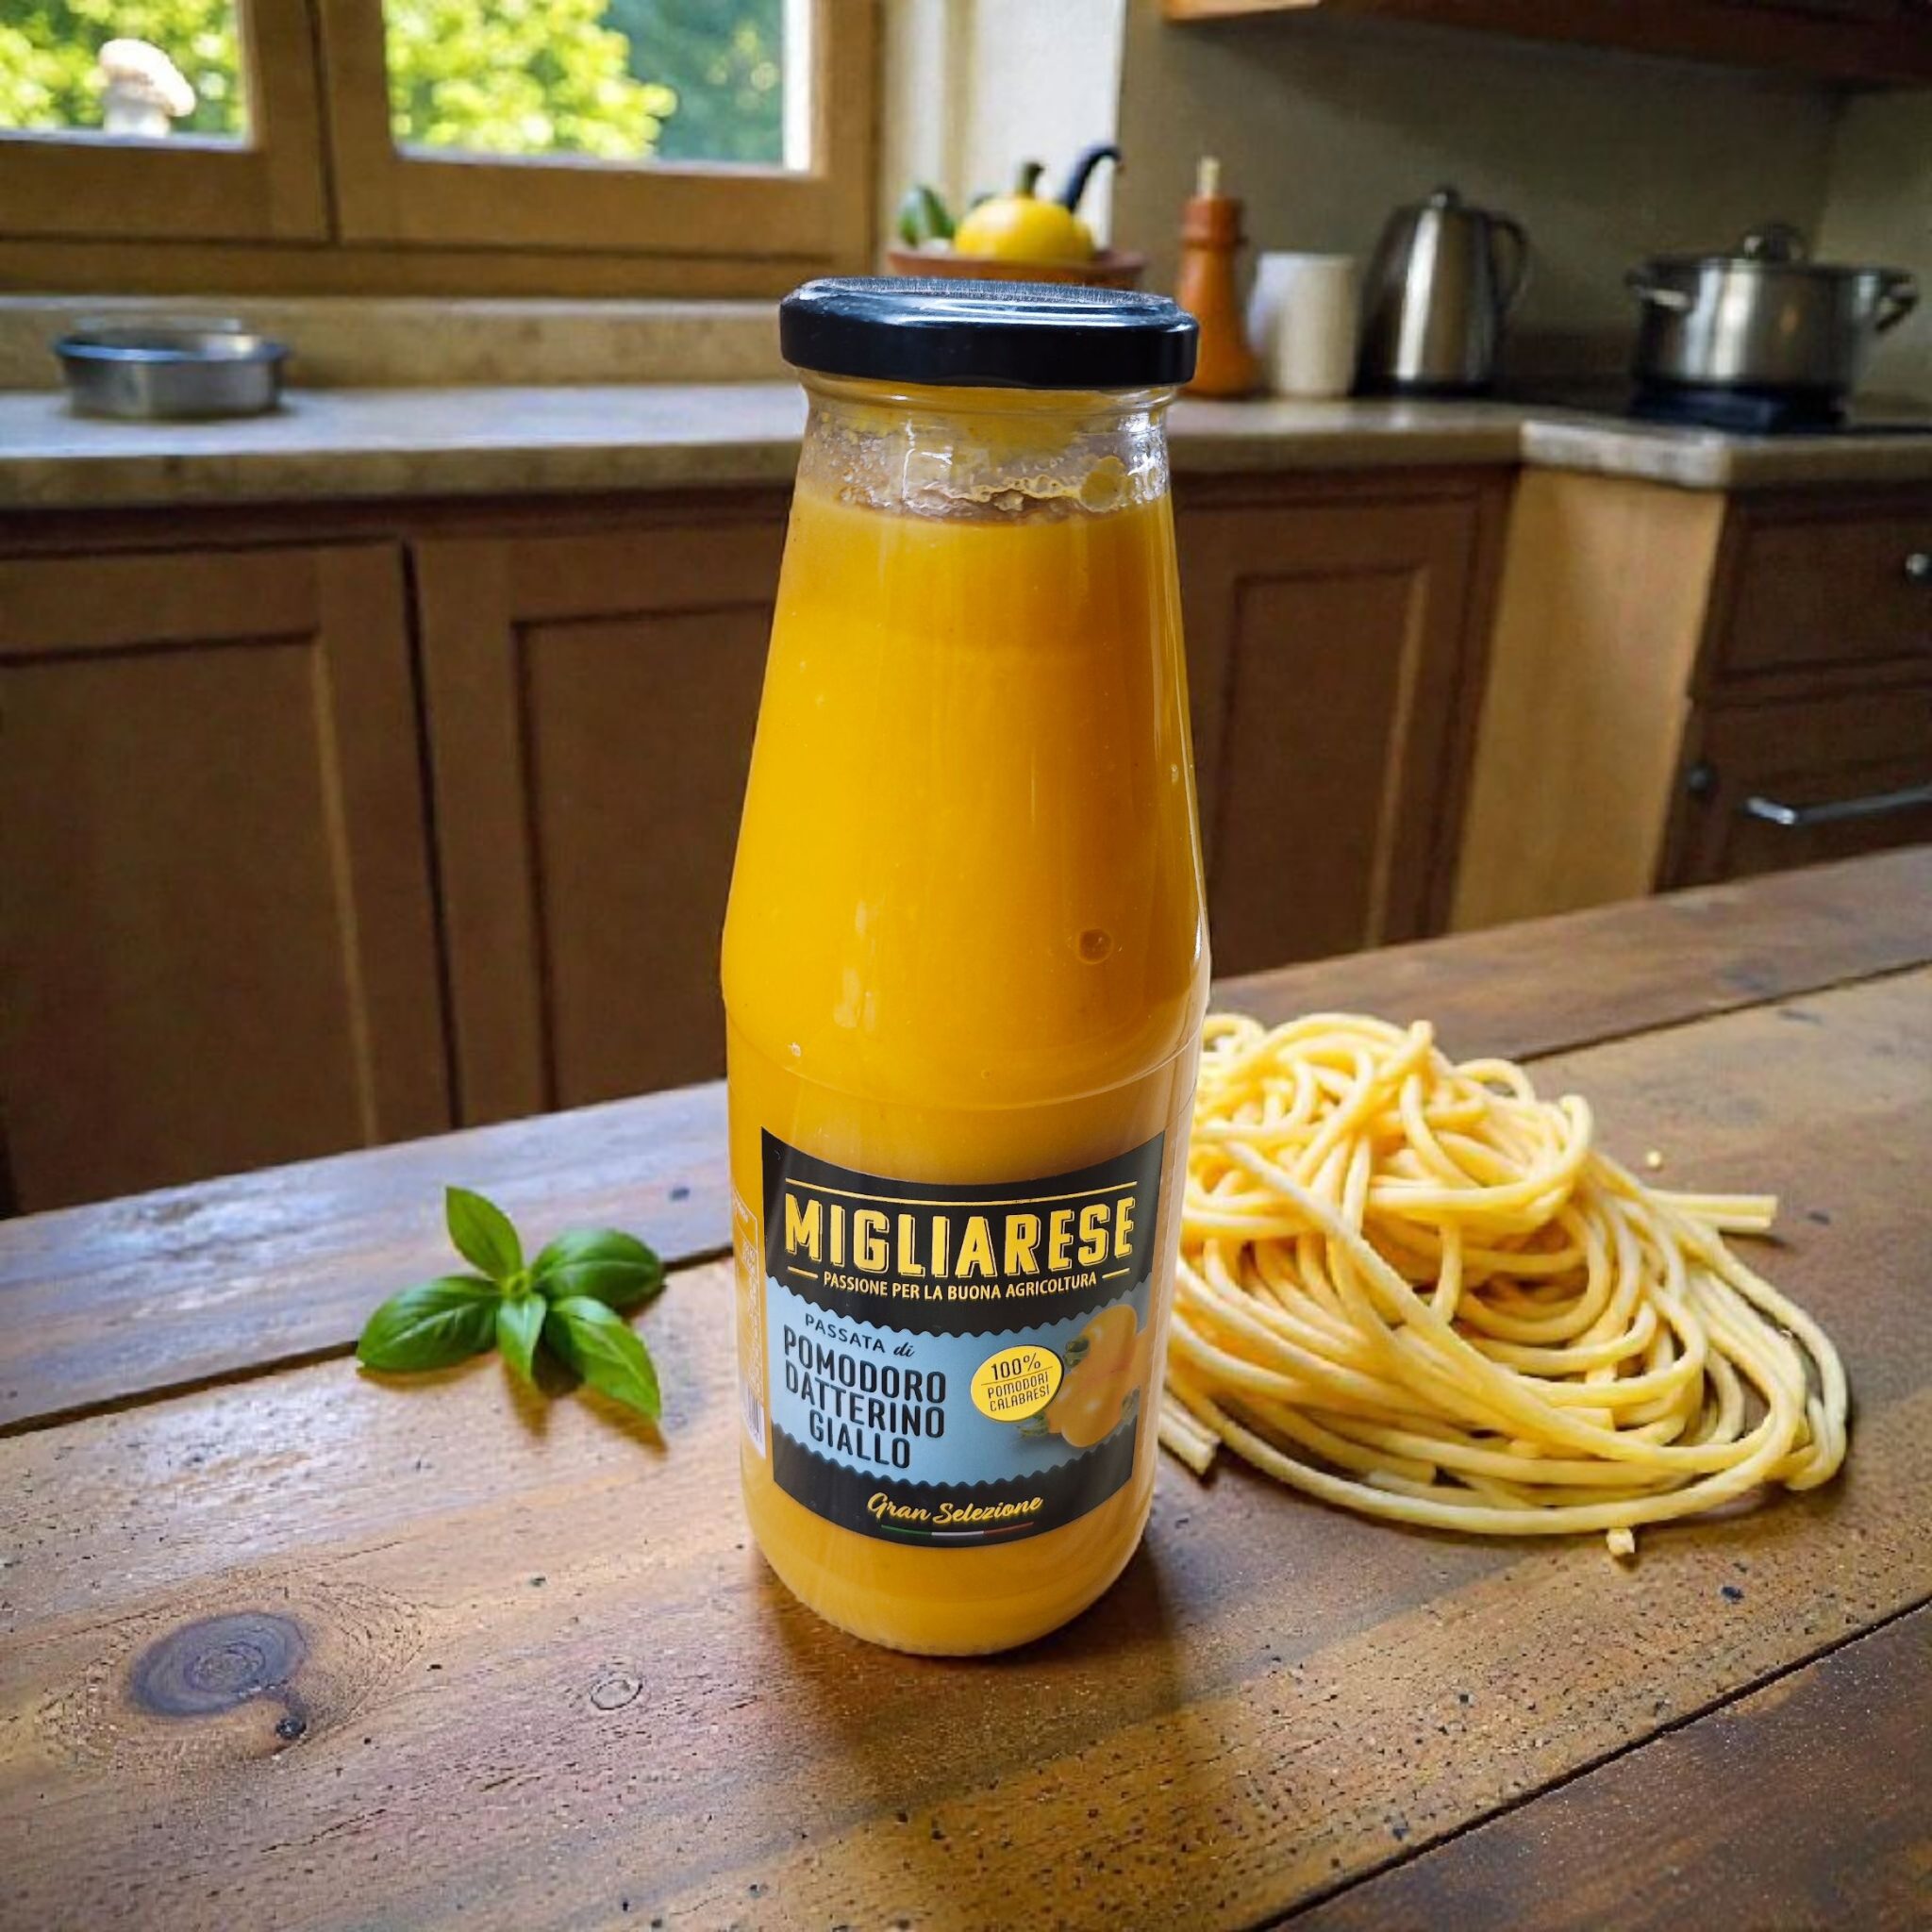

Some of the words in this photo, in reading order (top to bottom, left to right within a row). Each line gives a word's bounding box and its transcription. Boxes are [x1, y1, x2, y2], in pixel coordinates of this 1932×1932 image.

[784, 1192, 1136, 1278] MIGLIARESE
[823, 1271, 888, 1297] PASSIONE
[891, 1284, 921, 1299] PER
[924, 1286, 942, 1300] LA
[947, 1285, 1001, 1301] BUONA
[1006, 1271, 1097, 1299] AGRICOLTURA
[805, 1312, 886, 1354] PASSATA
[893, 1340, 915, 1358] di
[783, 1324, 946, 1405] POMODORO
[990, 1352, 1041, 1382] 100%
[785, 1358, 945, 1440] DATTERINO
[987, 1371, 1049, 1400] POMODORI
[989, 1384, 1050, 1412] CALABRESI
[808, 1412, 910, 1470] GIALLO
[866, 1491, 932, 1522] Gran
[932, 1493, 1043, 1525] Selezione
